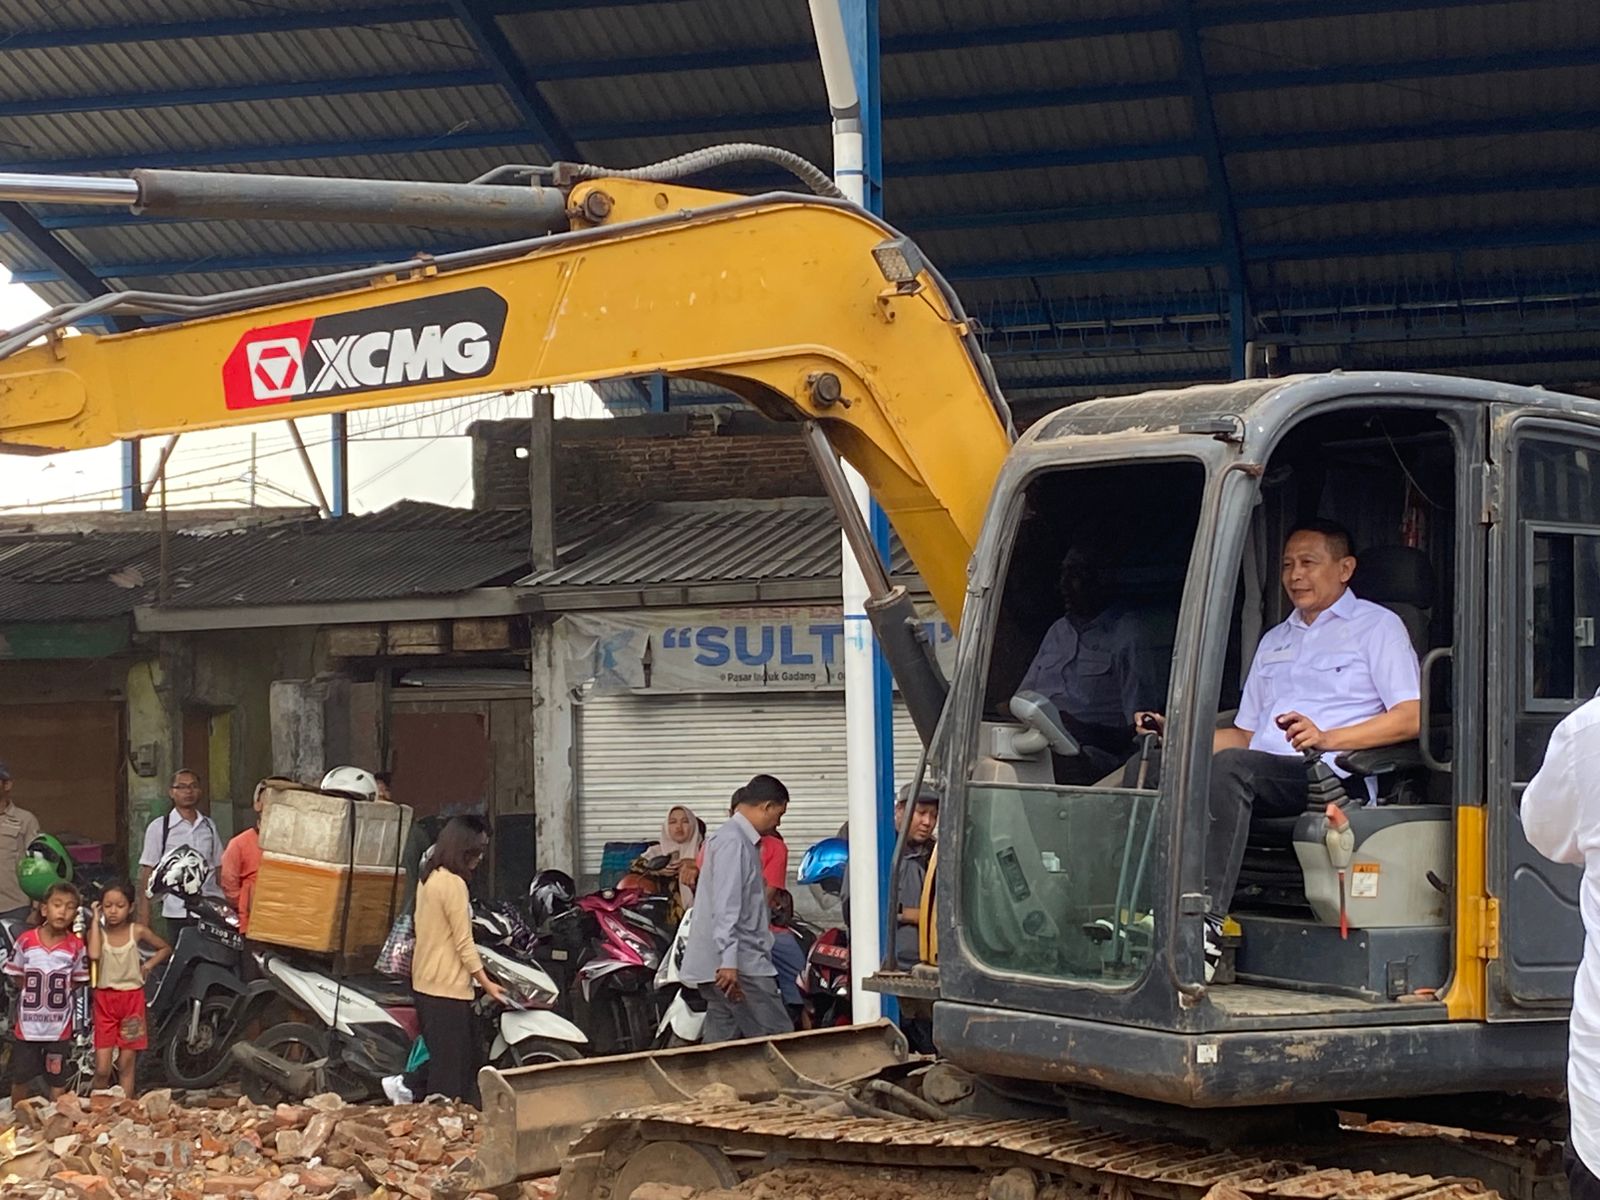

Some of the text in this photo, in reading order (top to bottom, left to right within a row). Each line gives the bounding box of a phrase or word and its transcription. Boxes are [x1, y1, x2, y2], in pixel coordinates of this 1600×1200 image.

[307, 321, 490, 393] XCMG
[727, 672, 752, 682] Pasar
[781, 671, 816, 683] Gadang
[22, 968, 69, 1011] 98
[23, 1013, 64, 1023] BROOKLYN
